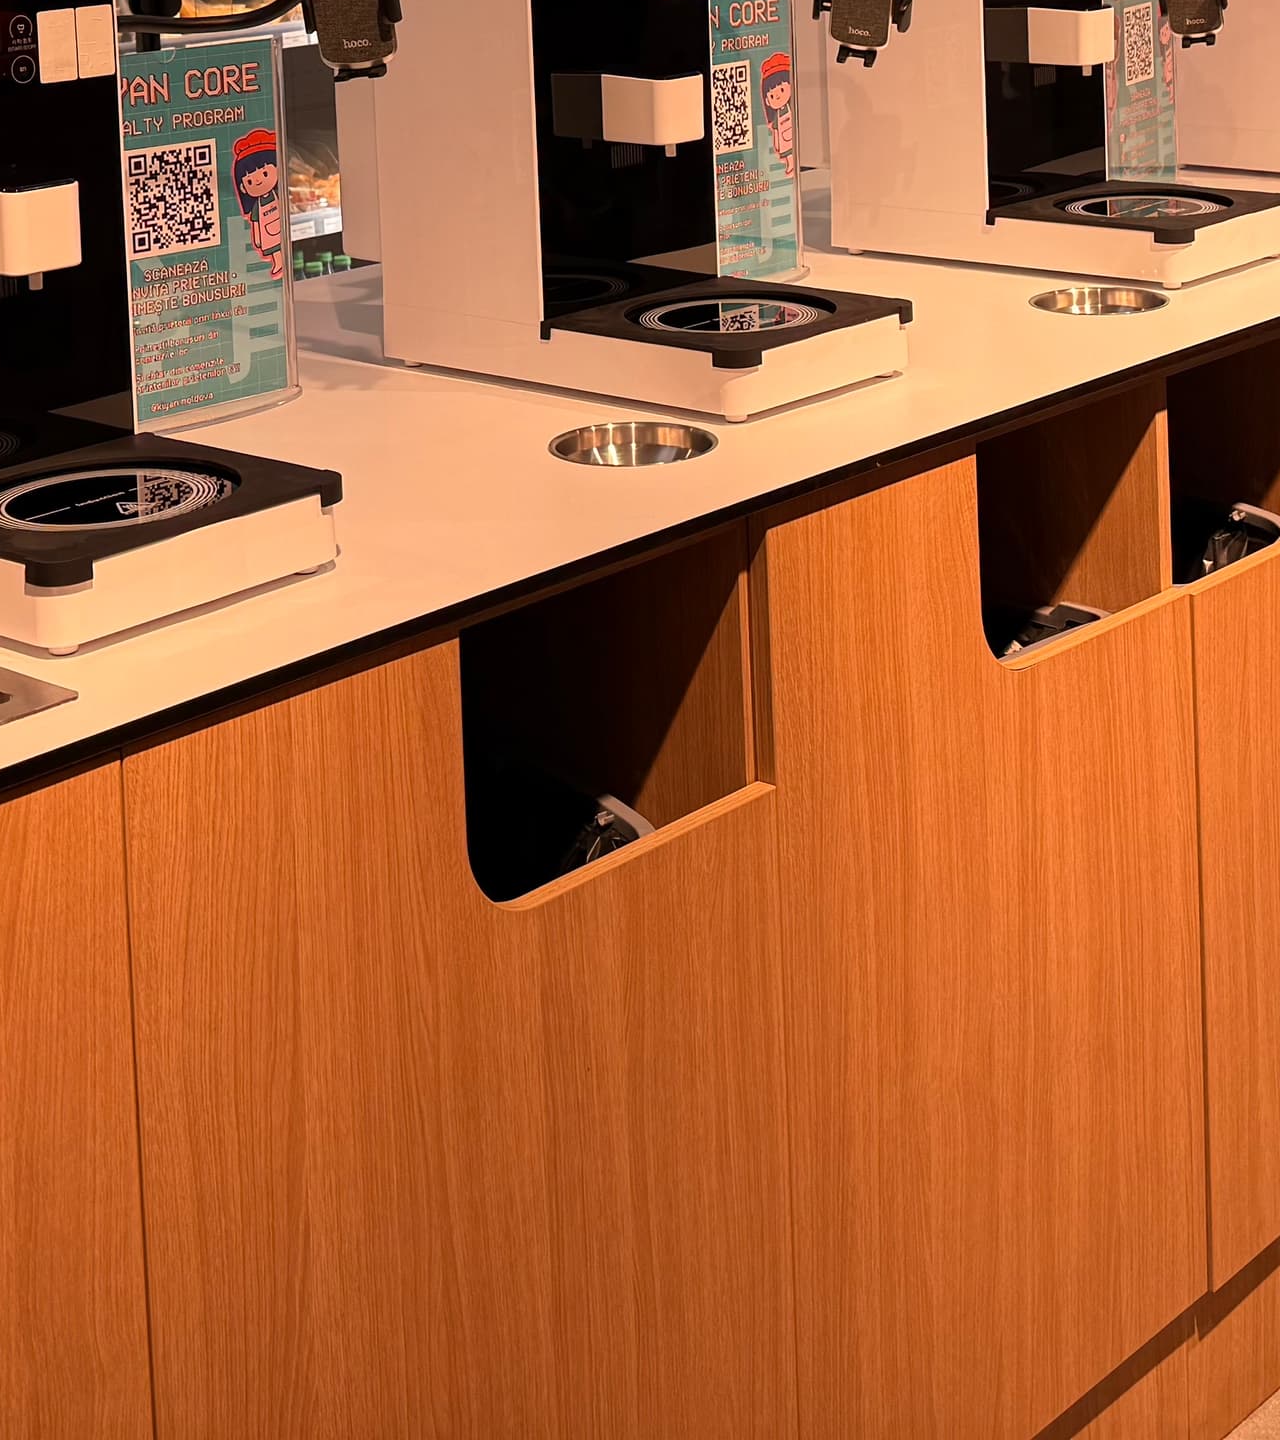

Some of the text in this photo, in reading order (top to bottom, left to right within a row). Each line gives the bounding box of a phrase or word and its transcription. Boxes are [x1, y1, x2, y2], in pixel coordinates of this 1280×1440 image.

[721, 34, 769, 51] PROGRAM
[185, 62, 260, 99] CORE
[172, 105, 245, 129] PROGRAM
[172, 271, 230, 293] PRIETENI
